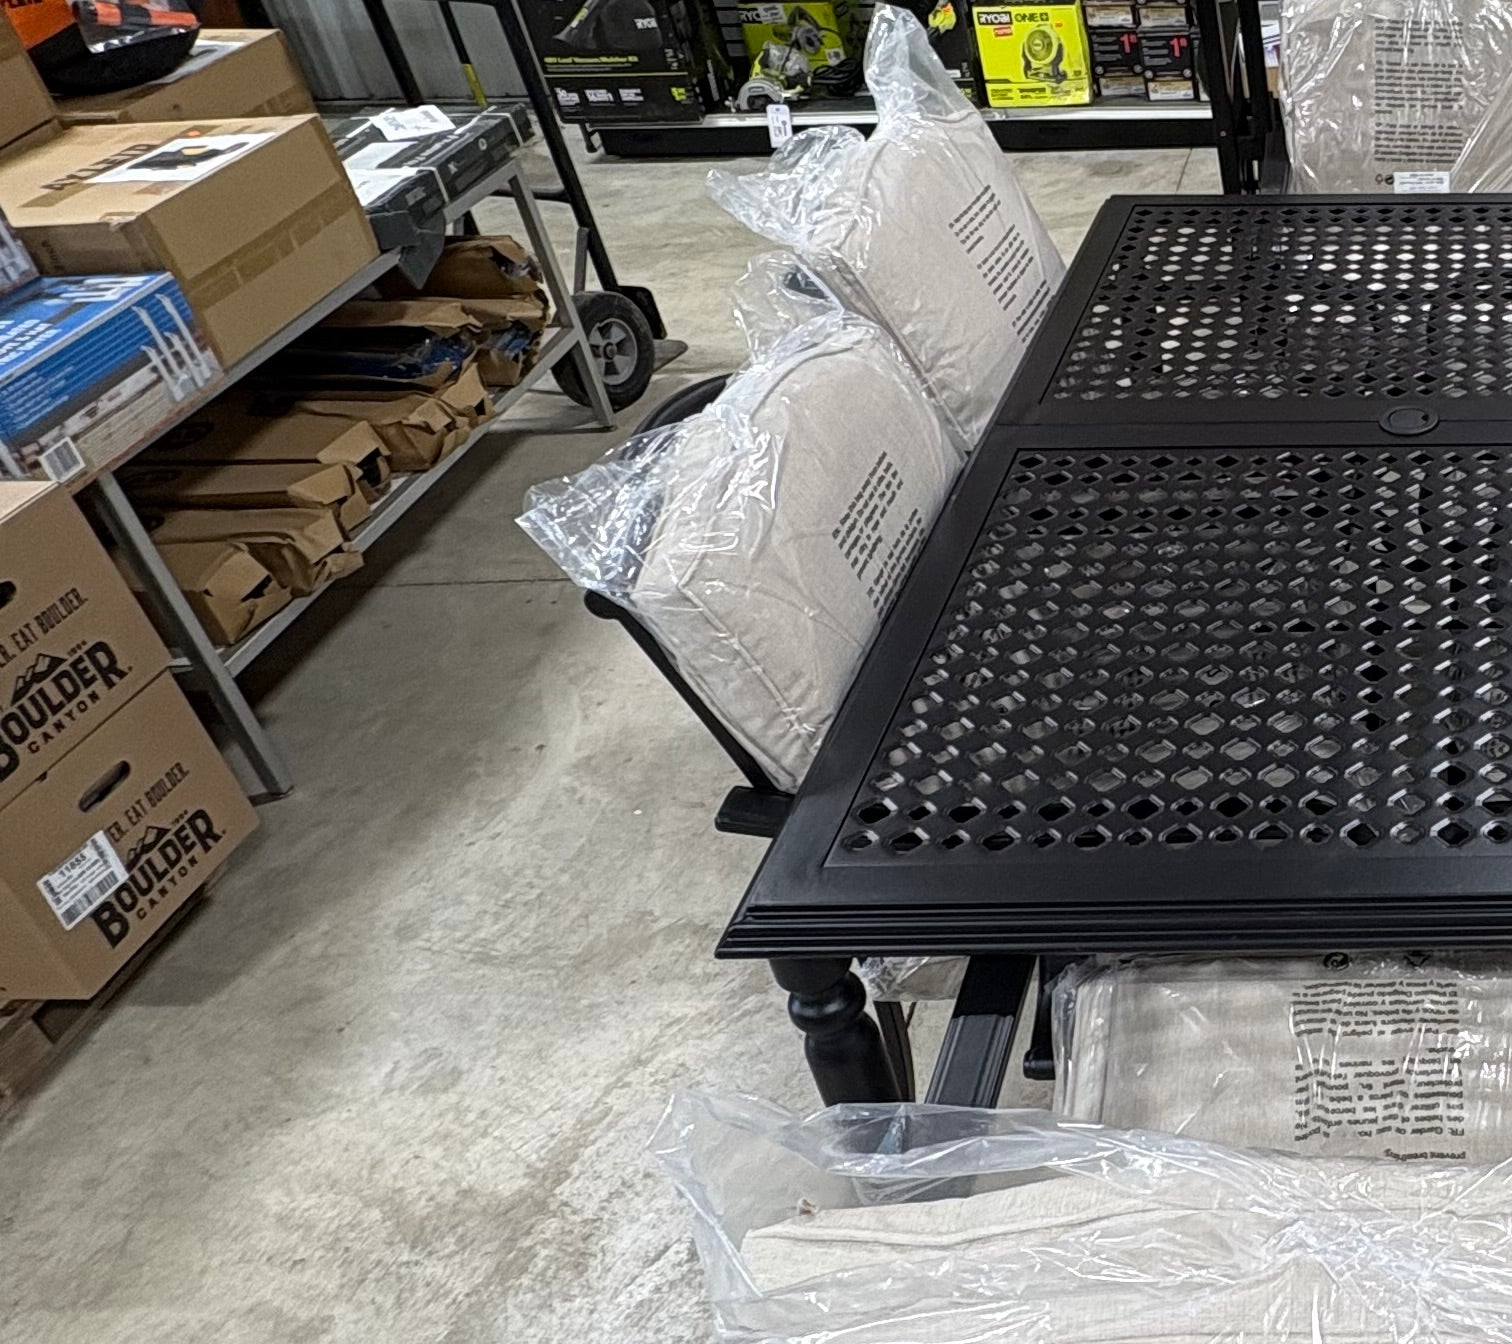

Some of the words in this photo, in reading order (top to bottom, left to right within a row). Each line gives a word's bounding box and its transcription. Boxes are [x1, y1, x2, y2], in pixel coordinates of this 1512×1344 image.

[978, 13, 1011, 24] RYOBI
[10, 622, 39, 652] EAT
[27, 690, 100, 754] CANYON
[124, 799, 148, 826] EAT
[90, 809, 222, 949] BOULDER
[136, 857, 198, 920] CANYON
[1354, 1068, 1399, 1078] provoquer
[1348, 1116, 1377, 1125] jeunes
